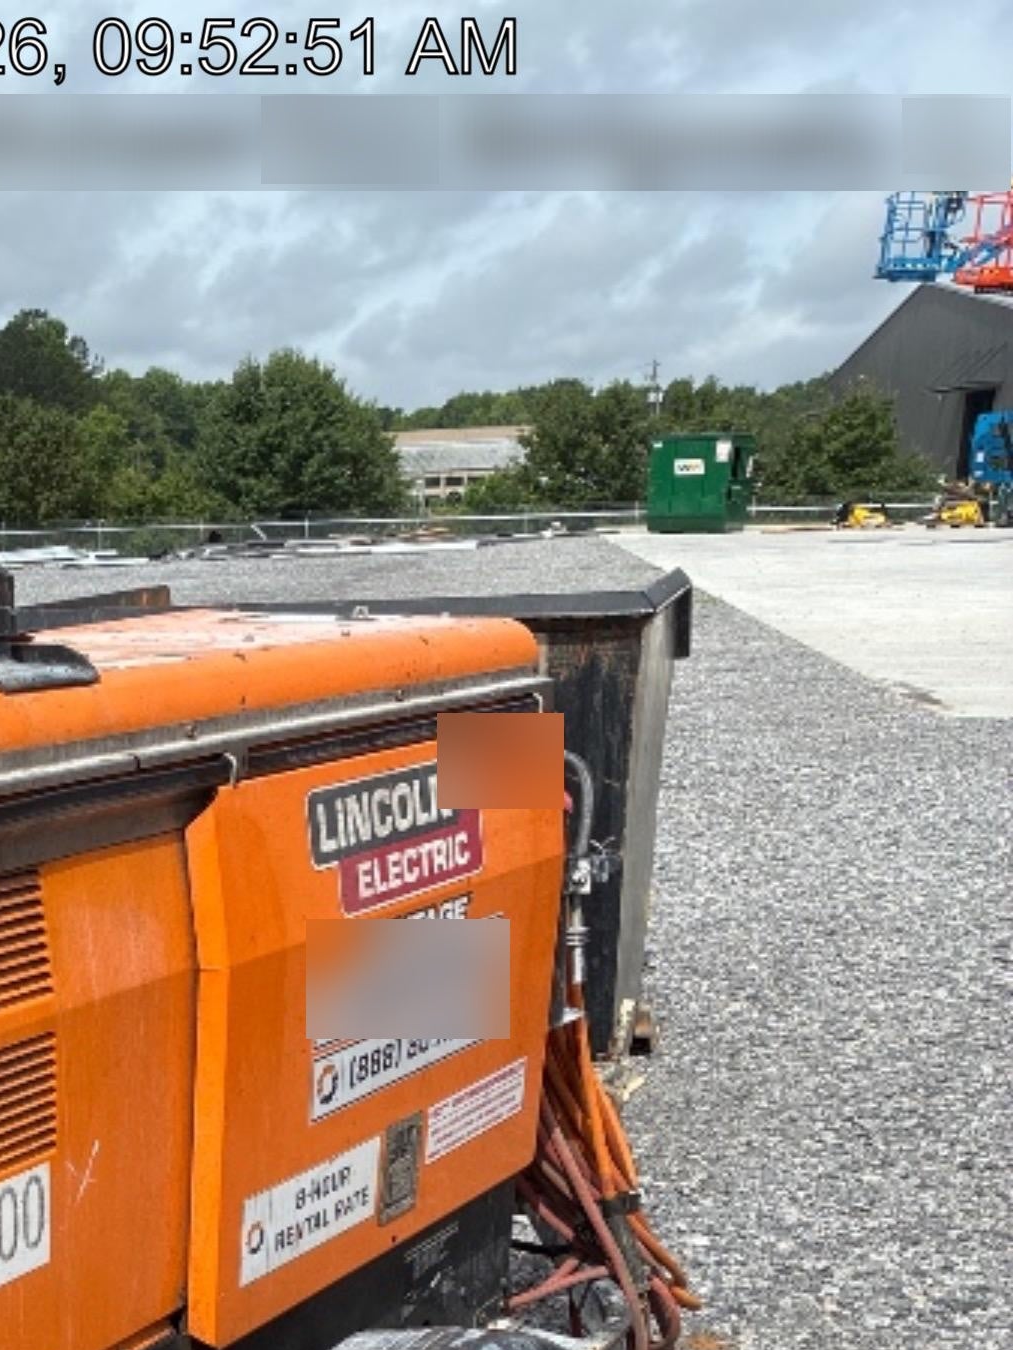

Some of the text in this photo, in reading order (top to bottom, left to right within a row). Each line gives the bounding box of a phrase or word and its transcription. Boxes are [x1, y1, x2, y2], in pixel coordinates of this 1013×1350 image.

[356, 831, 471, 898] ELECTRIC
[274, 1185, 370, 1252] RENTAL RATE
[295, 1166, 352, 1210] 8-HOUR
